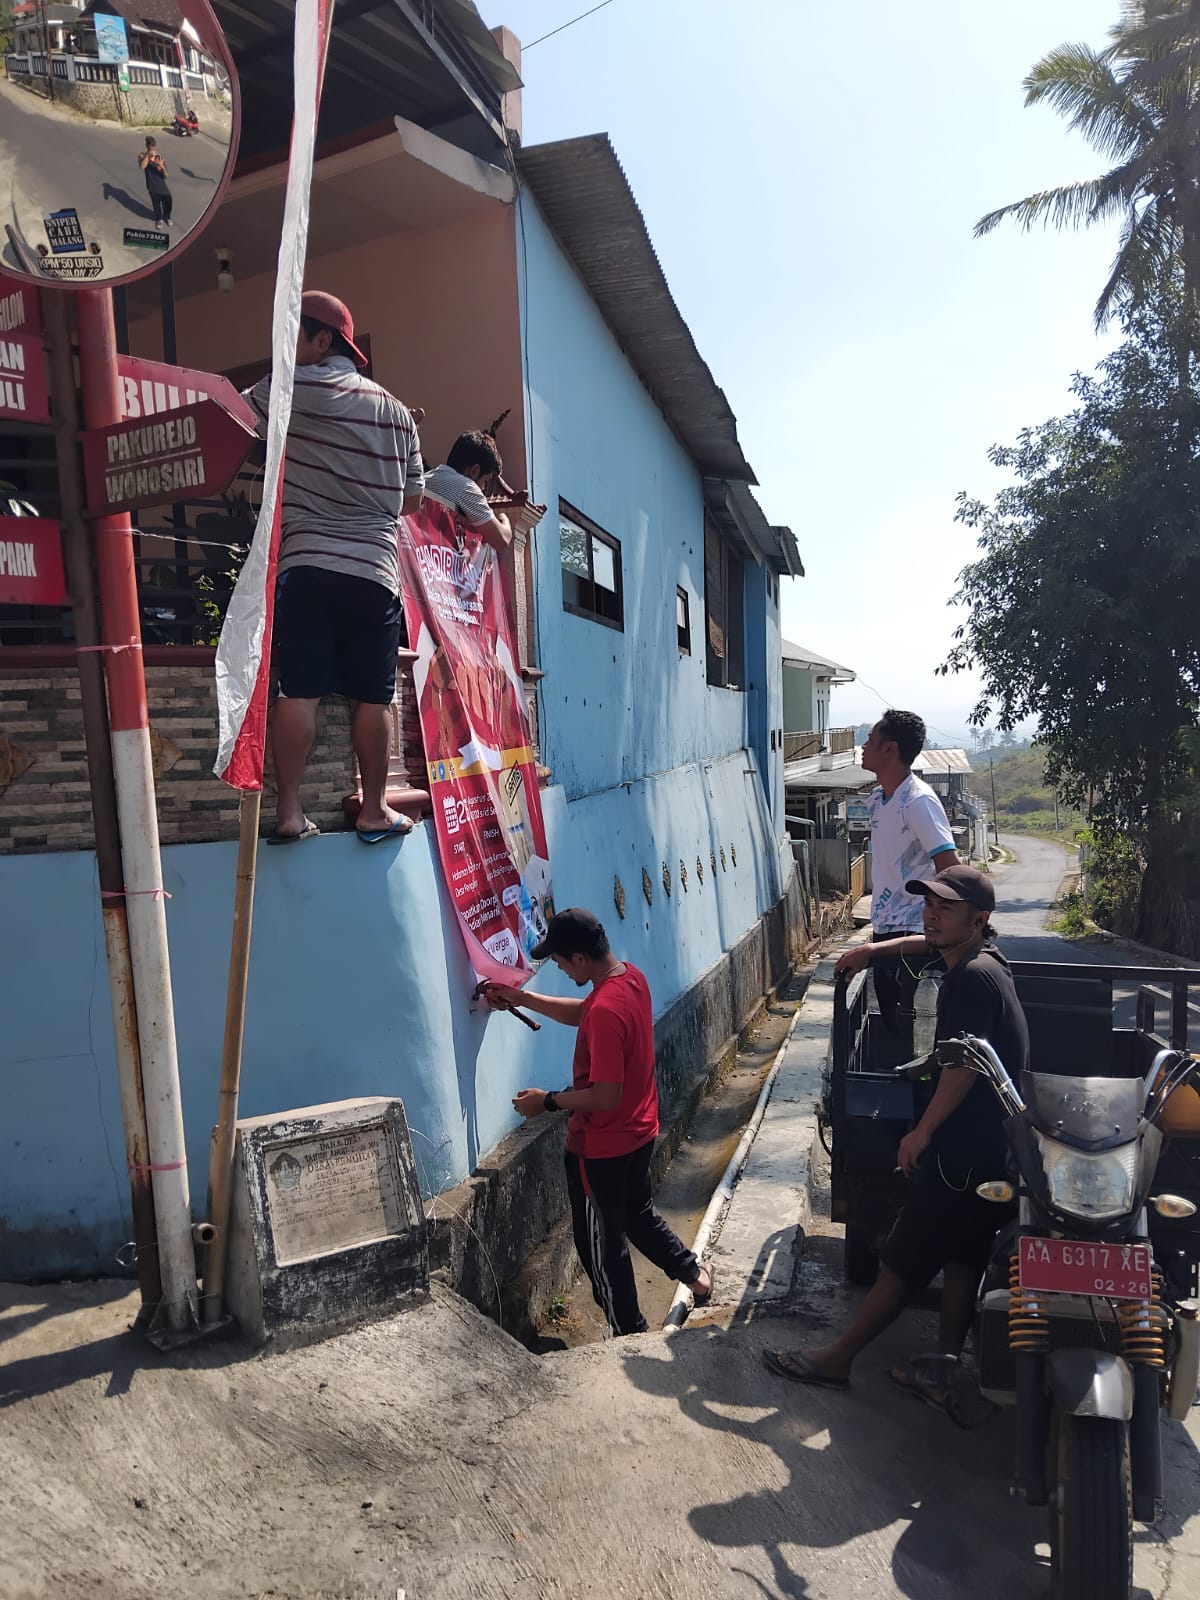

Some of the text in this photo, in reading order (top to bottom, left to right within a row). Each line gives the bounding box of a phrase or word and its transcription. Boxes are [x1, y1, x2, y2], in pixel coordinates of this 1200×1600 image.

[49, 226, 80, 237] CABE
[107, 416, 197, 464] PAKUREJO
[105, 456, 205, 503] WONOSARI
[1027, 1243, 1146, 1272] AA 6317 XE
